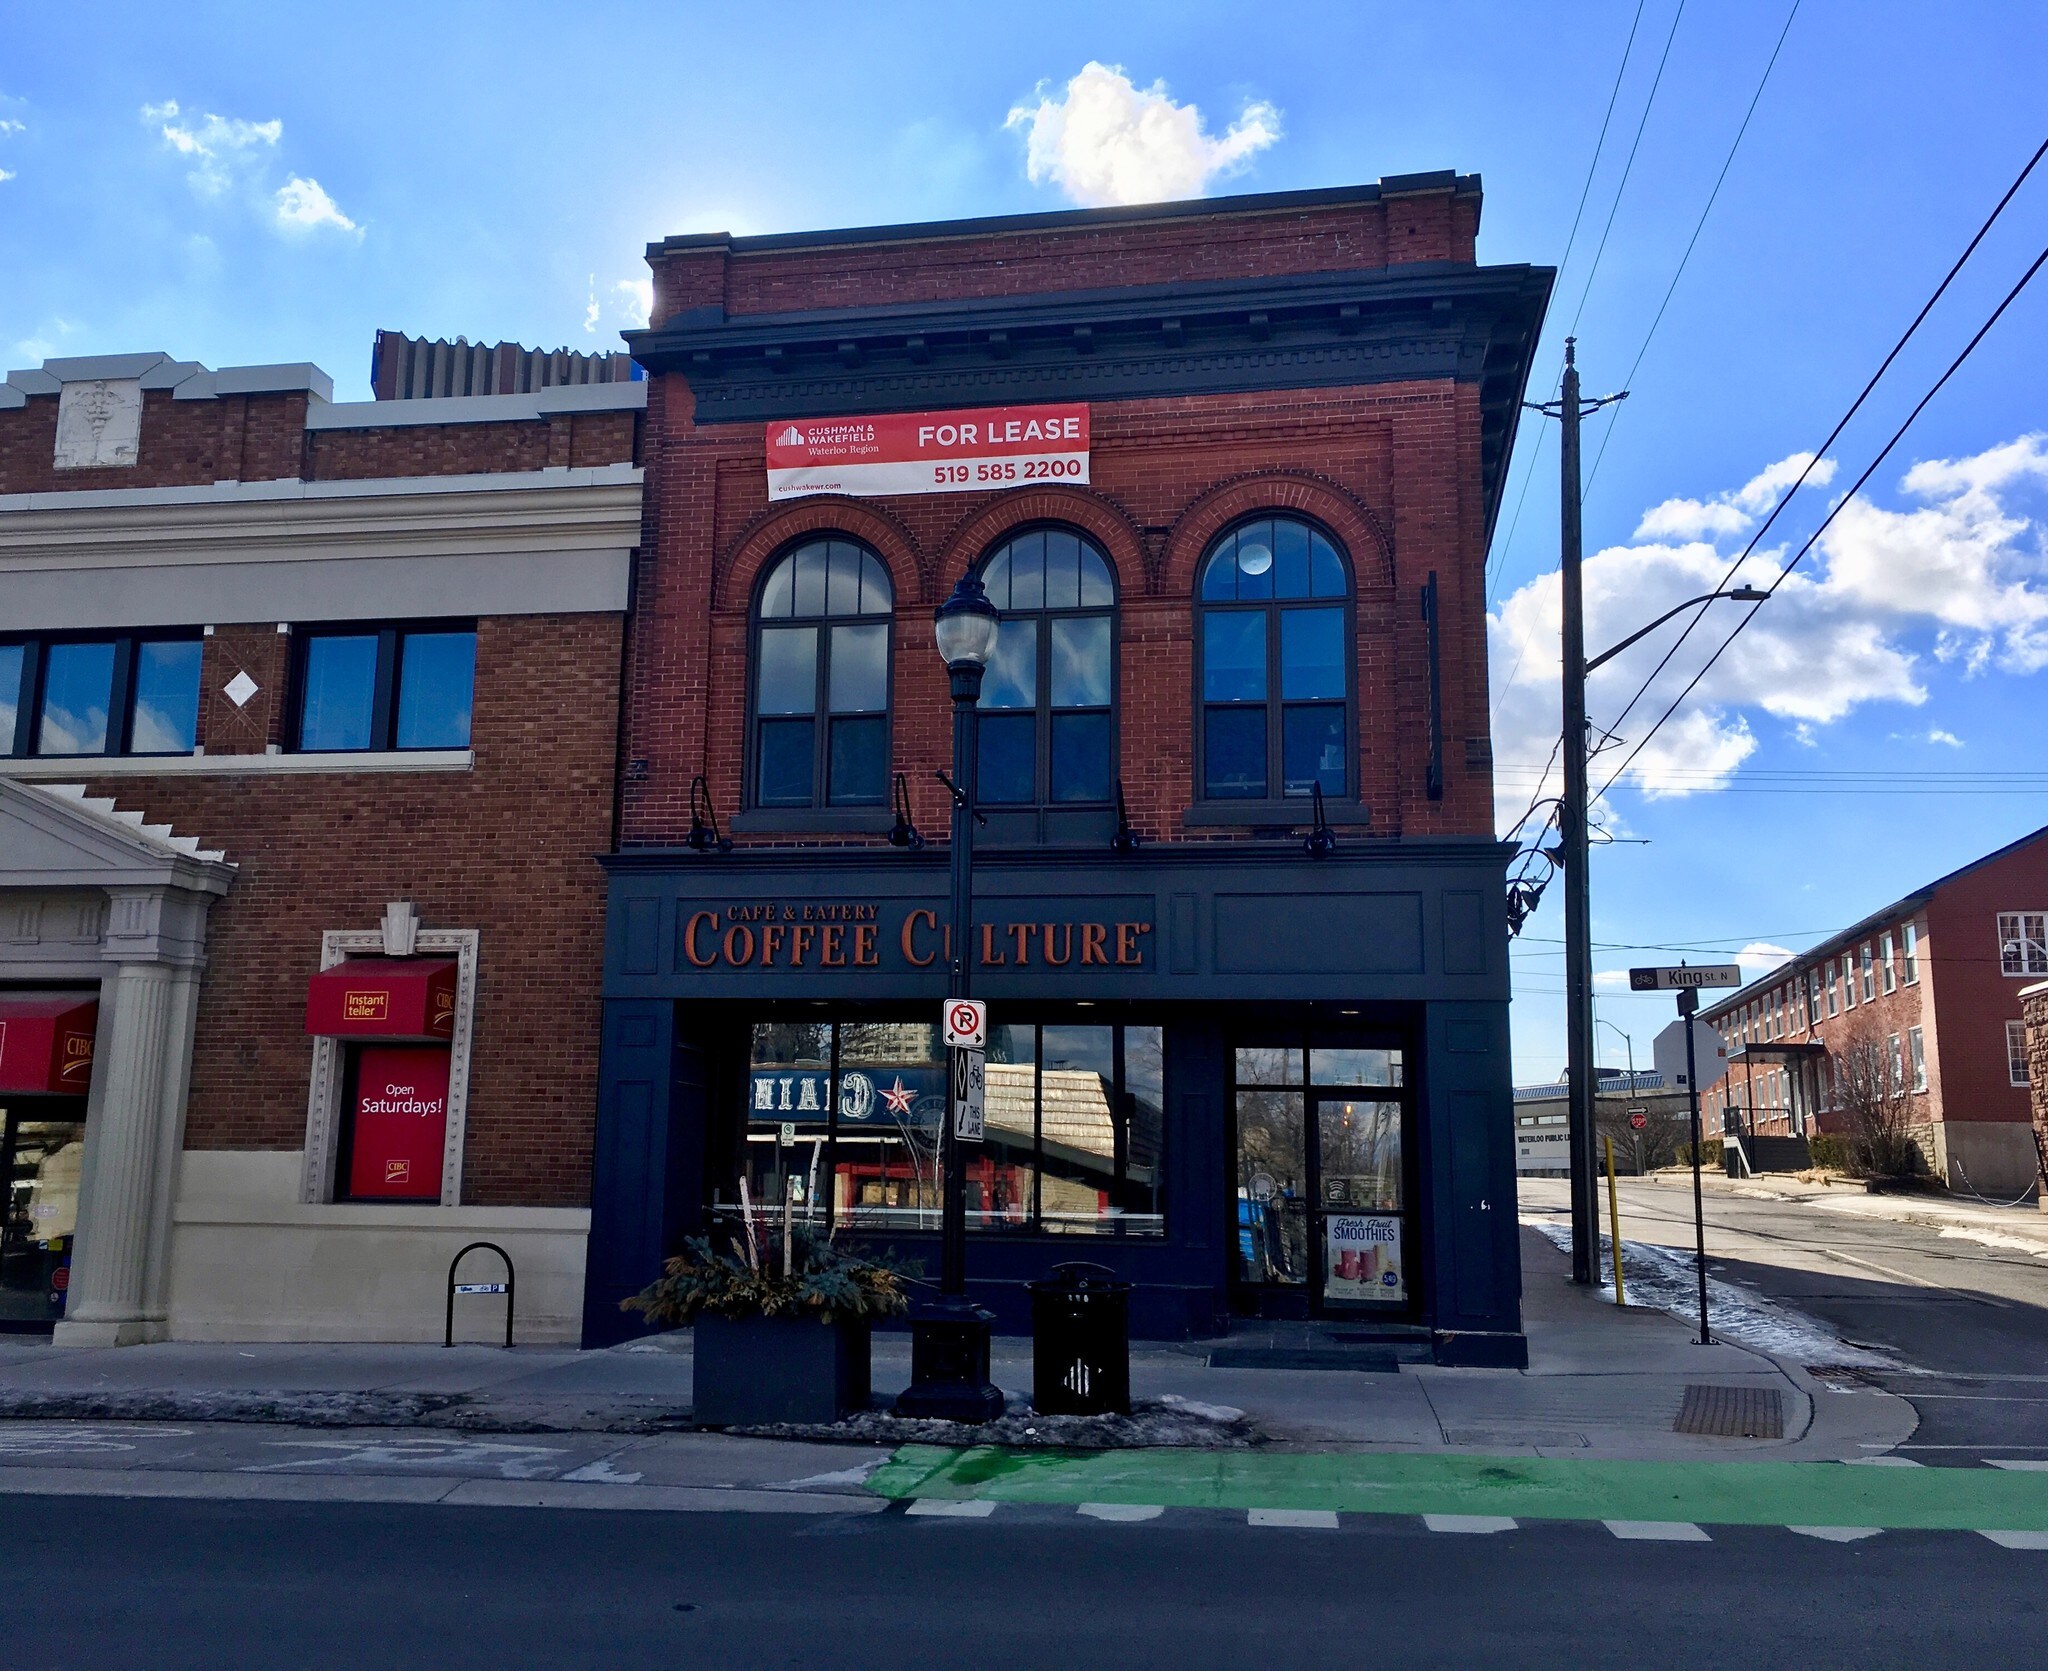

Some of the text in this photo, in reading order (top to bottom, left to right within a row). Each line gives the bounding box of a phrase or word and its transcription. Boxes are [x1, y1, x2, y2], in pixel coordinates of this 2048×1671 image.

[808, 424, 874, 436] CUSHMAN &
[918, 417, 1080, 448] FOR LEASE
[808, 432, 875, 445] WAKEFIELD
[808, 444, 879, 456] Waterloo Region
[934, 459, 1081, 484] 519 585 2200
[778, 483, 841, 492] cushwakewr.com
[727, 904, 878, 921] CAFÉ & EATERY
[684, 911, 879, 966] COFFEE
[1668, 970, 1703, 986] King
[1721, 972, 1728, 980] N
[349, 995, 384, 1005] Instant
[436, 992, 455, 1010] CIBC
[348, 1006, 375, 1016] teller
[66, 1037, 95, 1056] CIBC
[385, 1084, 415, 1097] Open
[361, 1097, 442, 1117] Saturdays!
[969, 1105, 980, 1120] THIS
[968, 1122, 981, 1136] LANE
[1545, 1134, 1563, 1142] PUBLIC
[388, 1162, 408, 1171] CIBC
[1336, 1218, 1393, 1230] Fresh Fruit
[1333, 1227, 1395, 1242] SMOOTHIES
